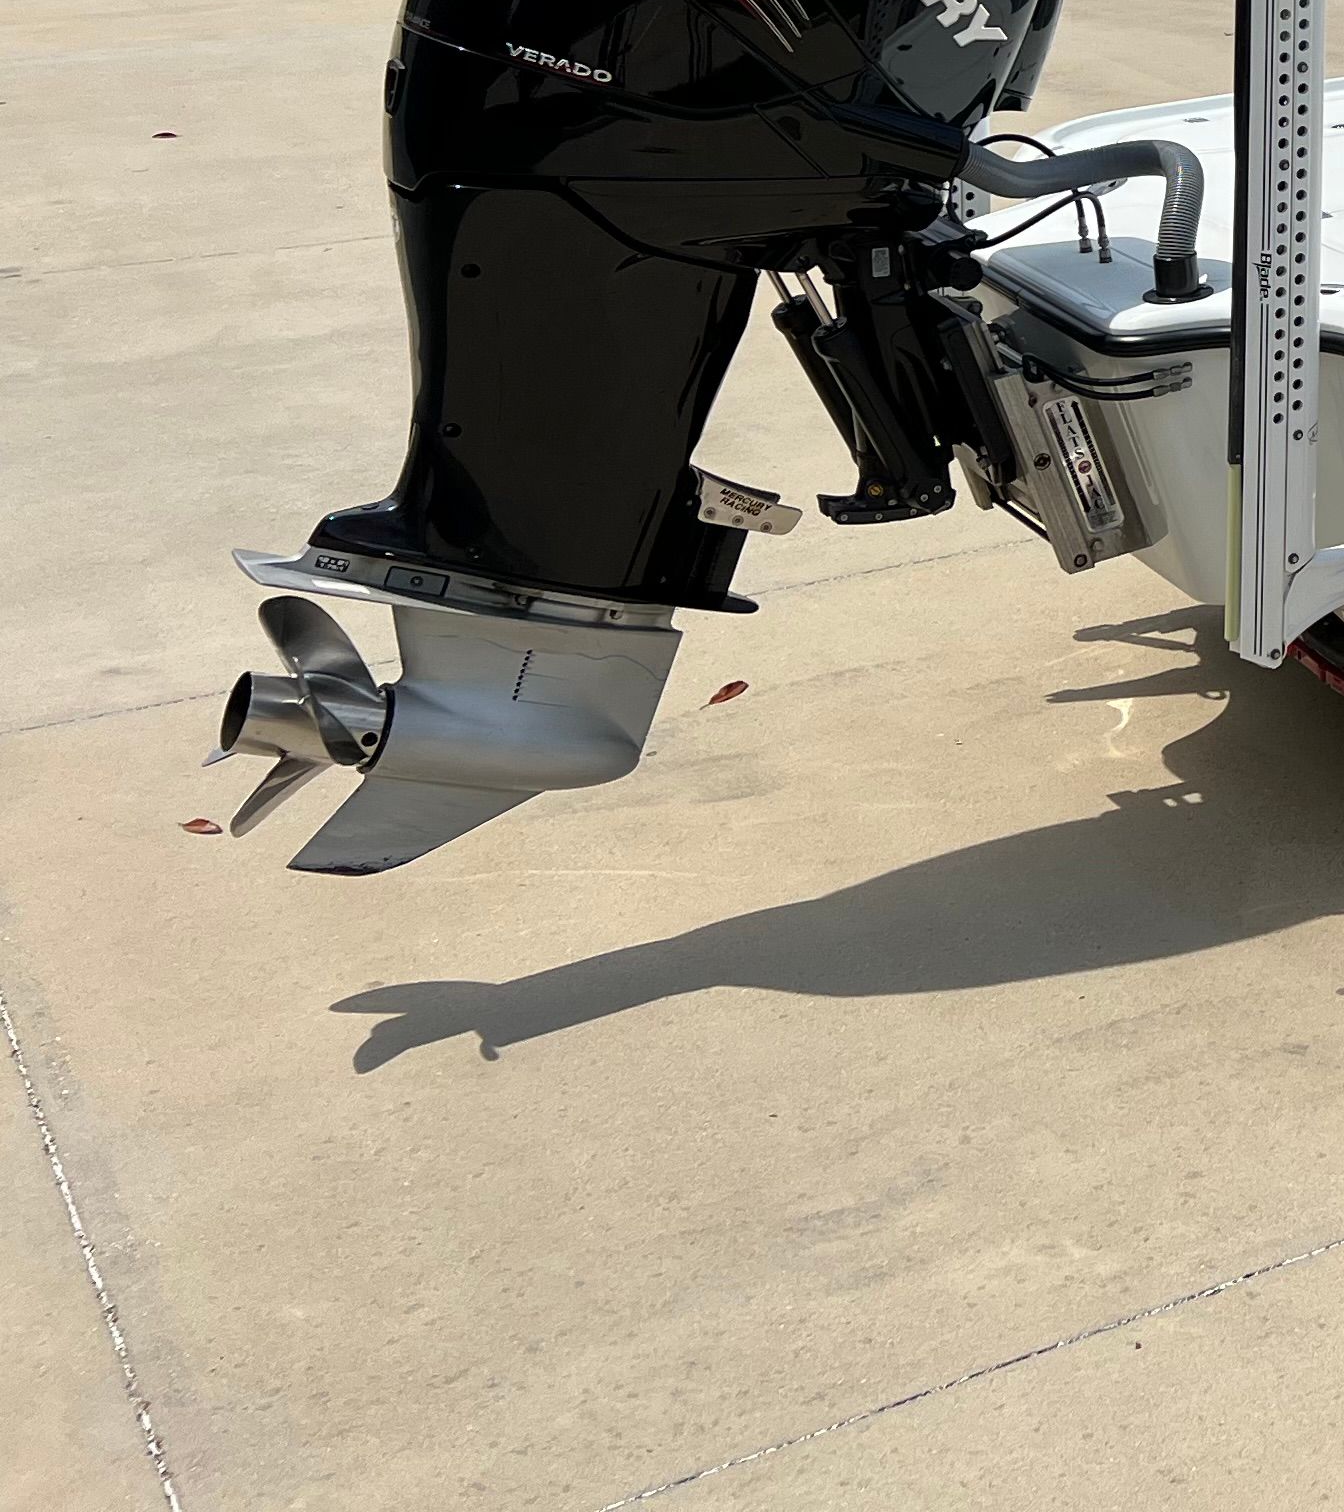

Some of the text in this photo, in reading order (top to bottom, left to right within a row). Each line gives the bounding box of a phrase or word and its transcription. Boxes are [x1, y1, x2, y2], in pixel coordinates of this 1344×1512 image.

[506, 42, 612, 82] VERADO
[1252, 253, 1272, 299] Blade
[1056, 399, 1085, 460] FLATS
[720, 488, 772, 511] MERCURY
[720, 497, 761, 516] RACING
